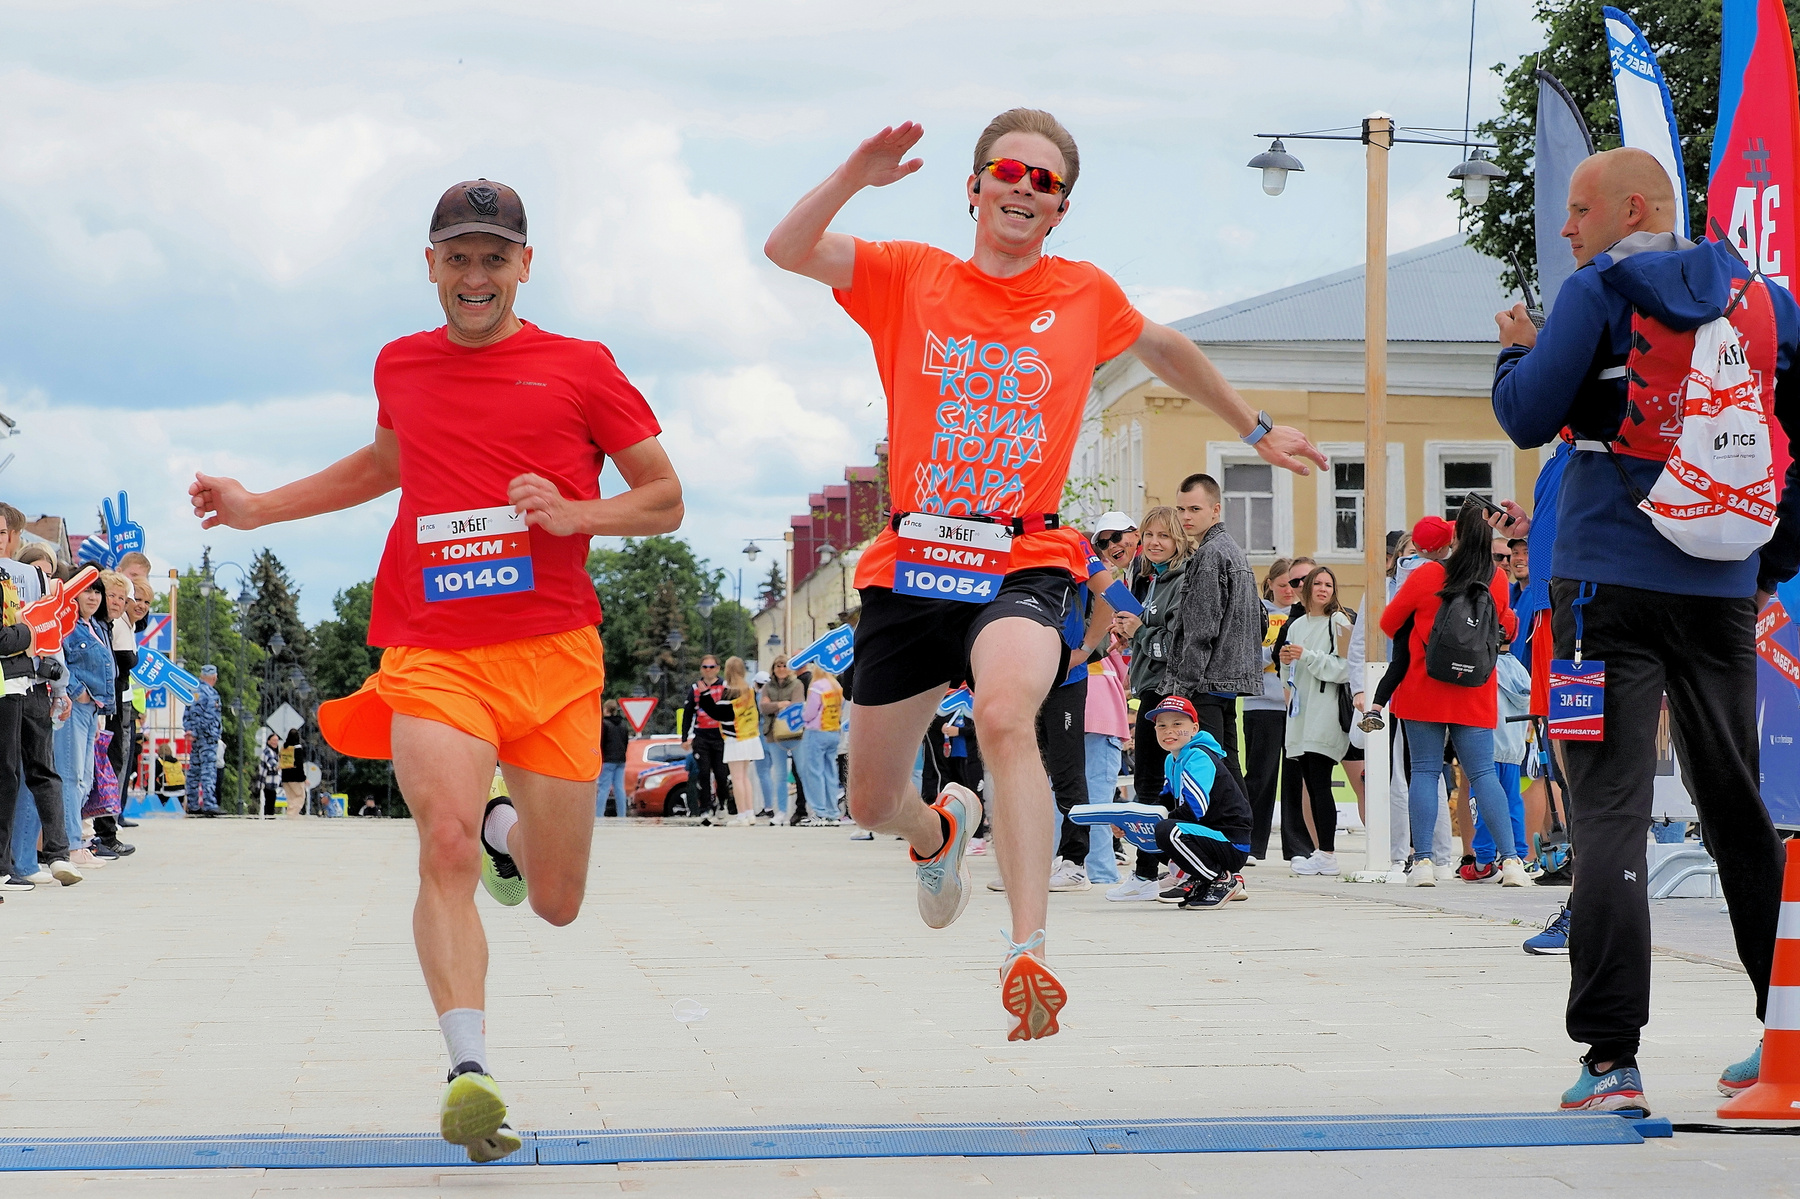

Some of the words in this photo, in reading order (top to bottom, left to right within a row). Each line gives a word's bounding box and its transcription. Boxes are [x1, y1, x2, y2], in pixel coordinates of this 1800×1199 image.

[944, 336, 1038, 374] МОС
[940, 368, 1020, 403] КОВ
[936, 401, 1042, 440] СКИЙ
[931, 432, 1038, 468] ПОЛУ
[1732, 434, 1756, 446] ПСБ
[930, 464, 1023, 498] МАРА
[1670, 505, 1726, 518] ЗАБЕГ.Р
[442, 540, 503, 560] 10КМ
[923, 546, 985, 567] 10КМ
[435, 566, 519, 593] 10140
[904, 570, 992, 597] 10054
[1594, 1075, 1618, 1095] HOKA
